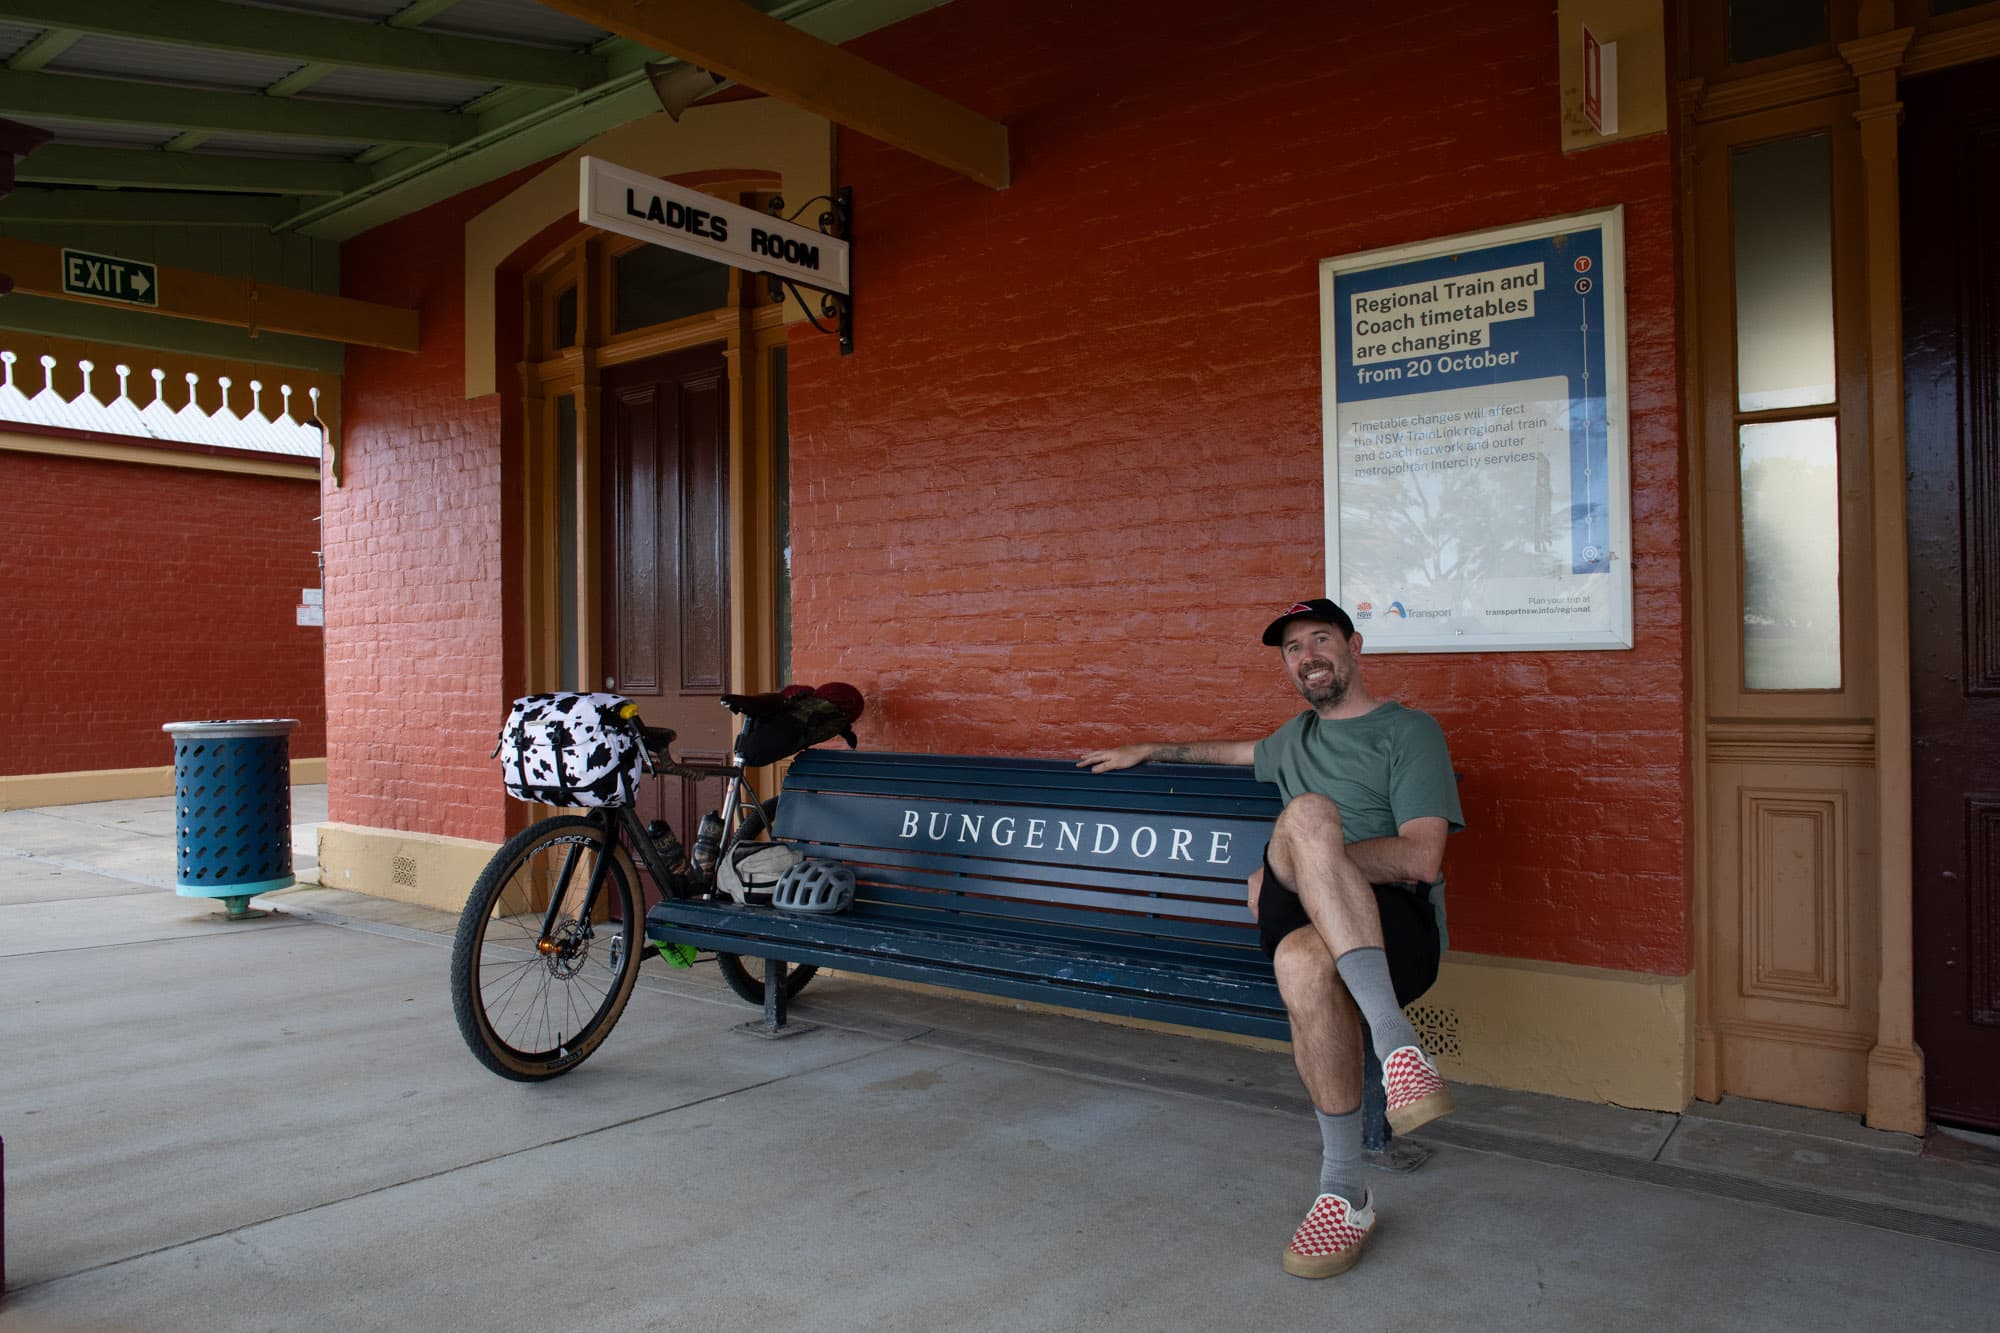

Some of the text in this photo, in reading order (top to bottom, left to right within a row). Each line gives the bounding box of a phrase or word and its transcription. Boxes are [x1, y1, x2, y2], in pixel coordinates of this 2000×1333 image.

[627, 188, 819, 270] LADIES ROOM
[69, 257, 125, 294] EXIT
[1356, 269, 1538, 315] Regional Train and
[1356, 297, 1528, 336] Coach timetables
[1356, 328, 1482, 359] are changing
[1357, 350, 1519, 385] from 20 October
[1352, 403, 1525, 433] Timetable changes will affect
[1354, 417, 1547, 447] the NSW TrainLink regional train
[1355, 436, 1526, 463] and coach network and outer
[1355, 451, 1538, 478] metropolitan Intercity services.
[1407, 608, 1452, 619] Transport
[1485, 605, 1591, 616] transportnsw.info/regional
[1528, 596, 1545, 605] Plan
[899, 810, 1233, 865] BUNGENDORE
